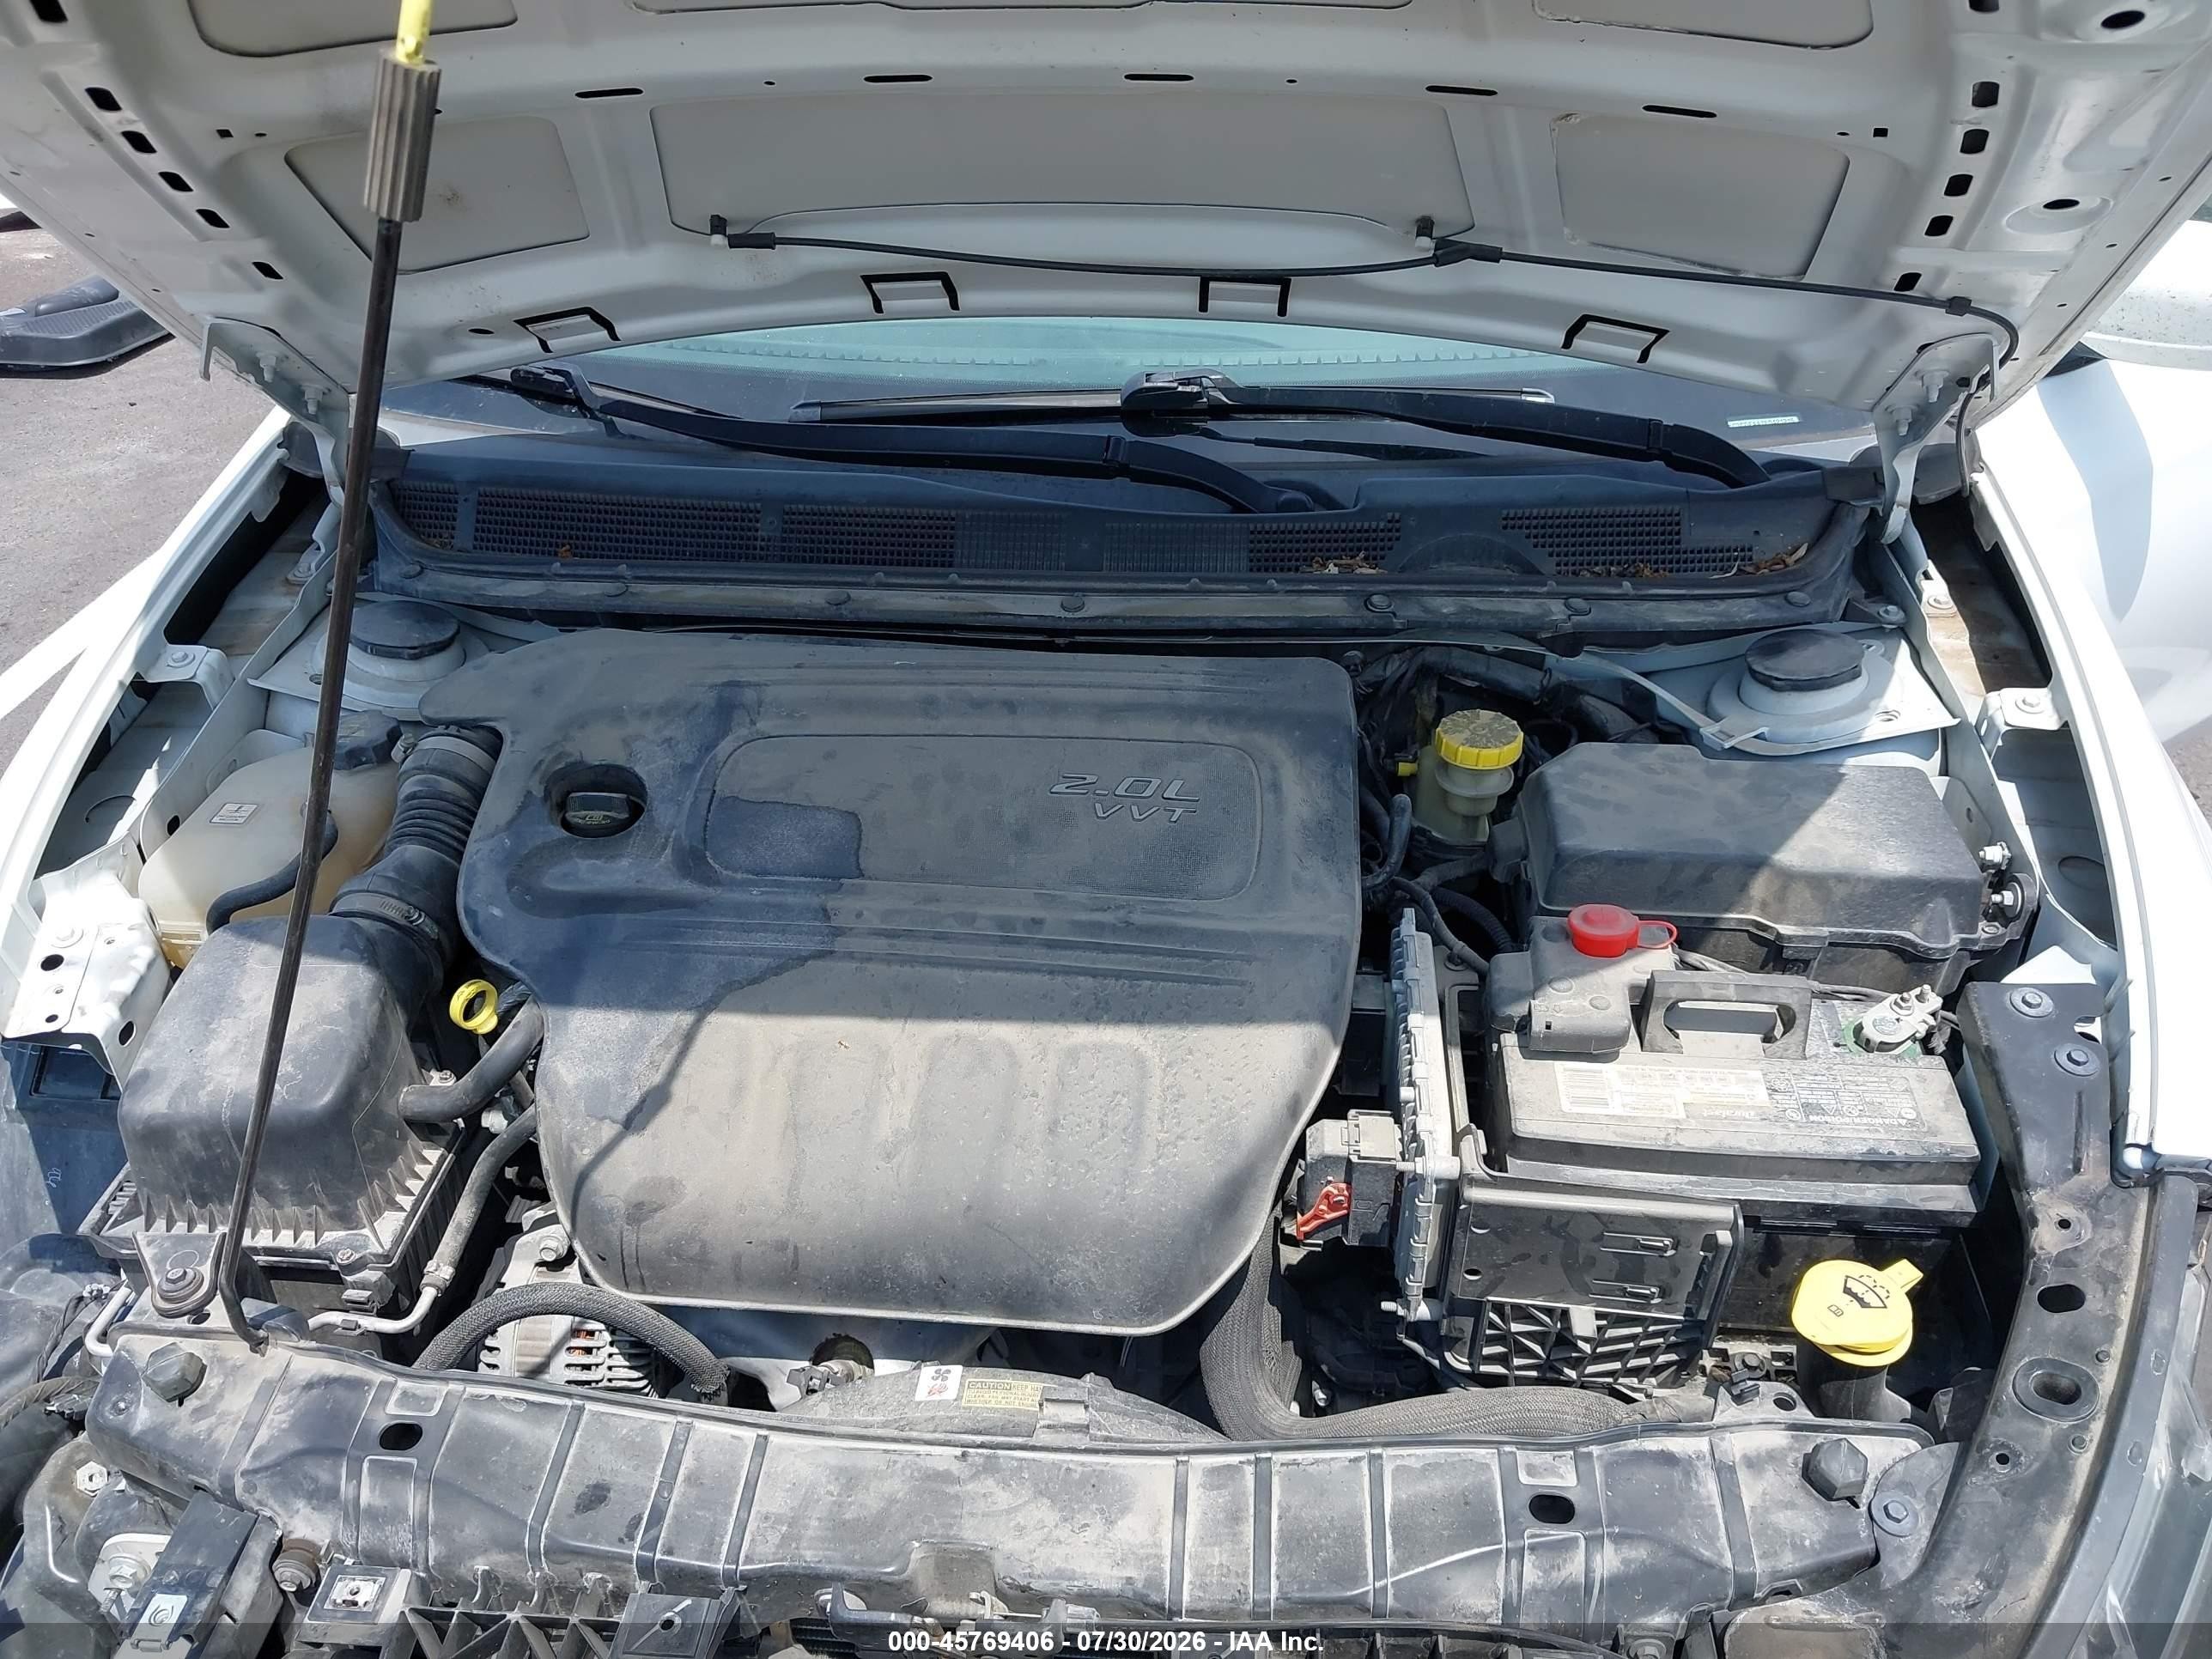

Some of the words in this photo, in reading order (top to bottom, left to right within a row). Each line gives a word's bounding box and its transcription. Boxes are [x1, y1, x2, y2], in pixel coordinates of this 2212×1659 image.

[1048, 772, 1200, 803] 2.0L
[1093, 802, 1197, 823] VVT
[969, 1382, 1011, 1390] CAUTION
